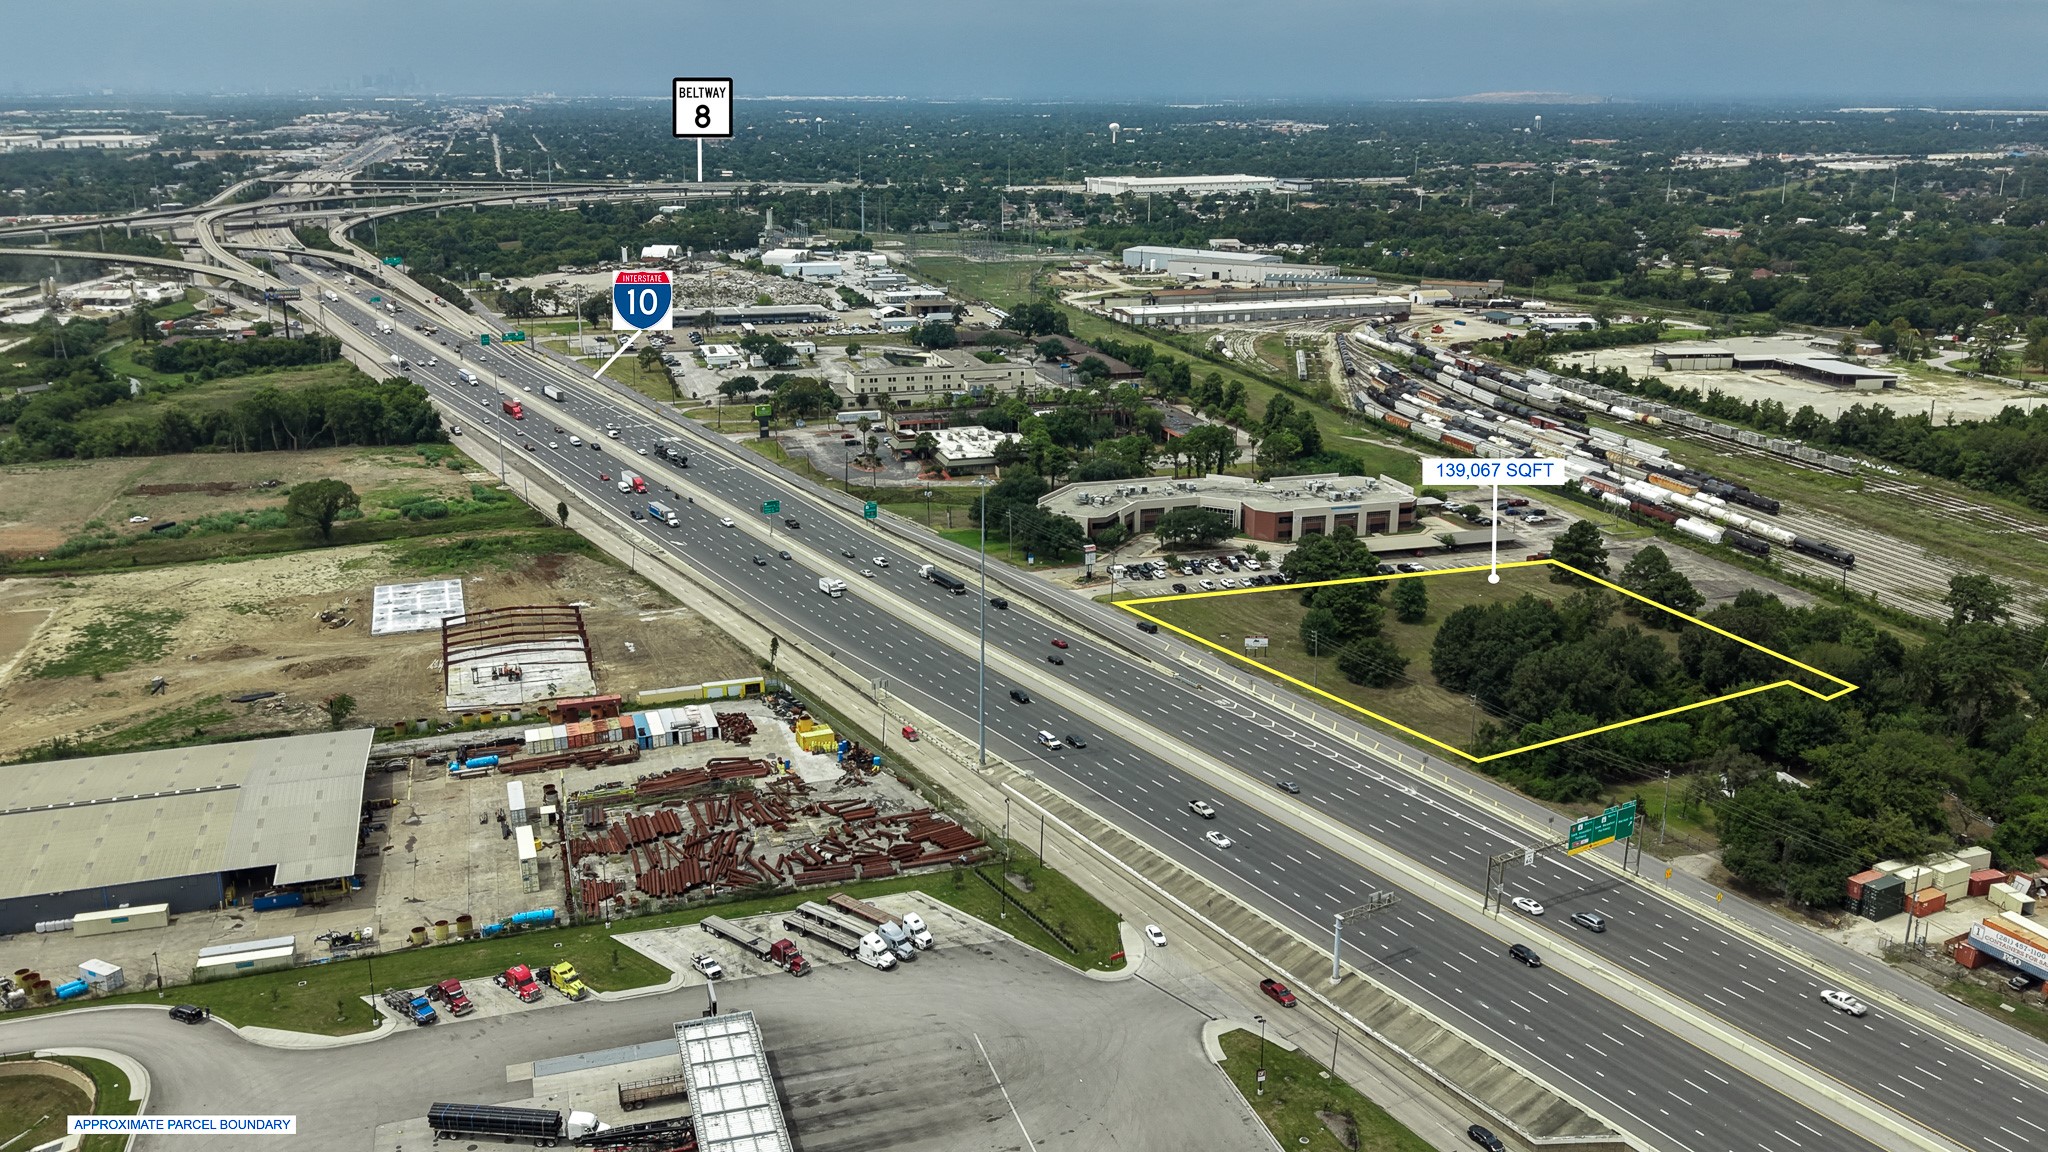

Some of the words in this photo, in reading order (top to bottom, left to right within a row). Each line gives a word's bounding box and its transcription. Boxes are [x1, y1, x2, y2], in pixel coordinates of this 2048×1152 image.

[1985, 935, 2025, 956] CONTAINERS
[2025, 953, 2039, 962] FOR
[1996, 933, 2014, 945] (281)
[2015, 942, 2046, 959] 457-1100
